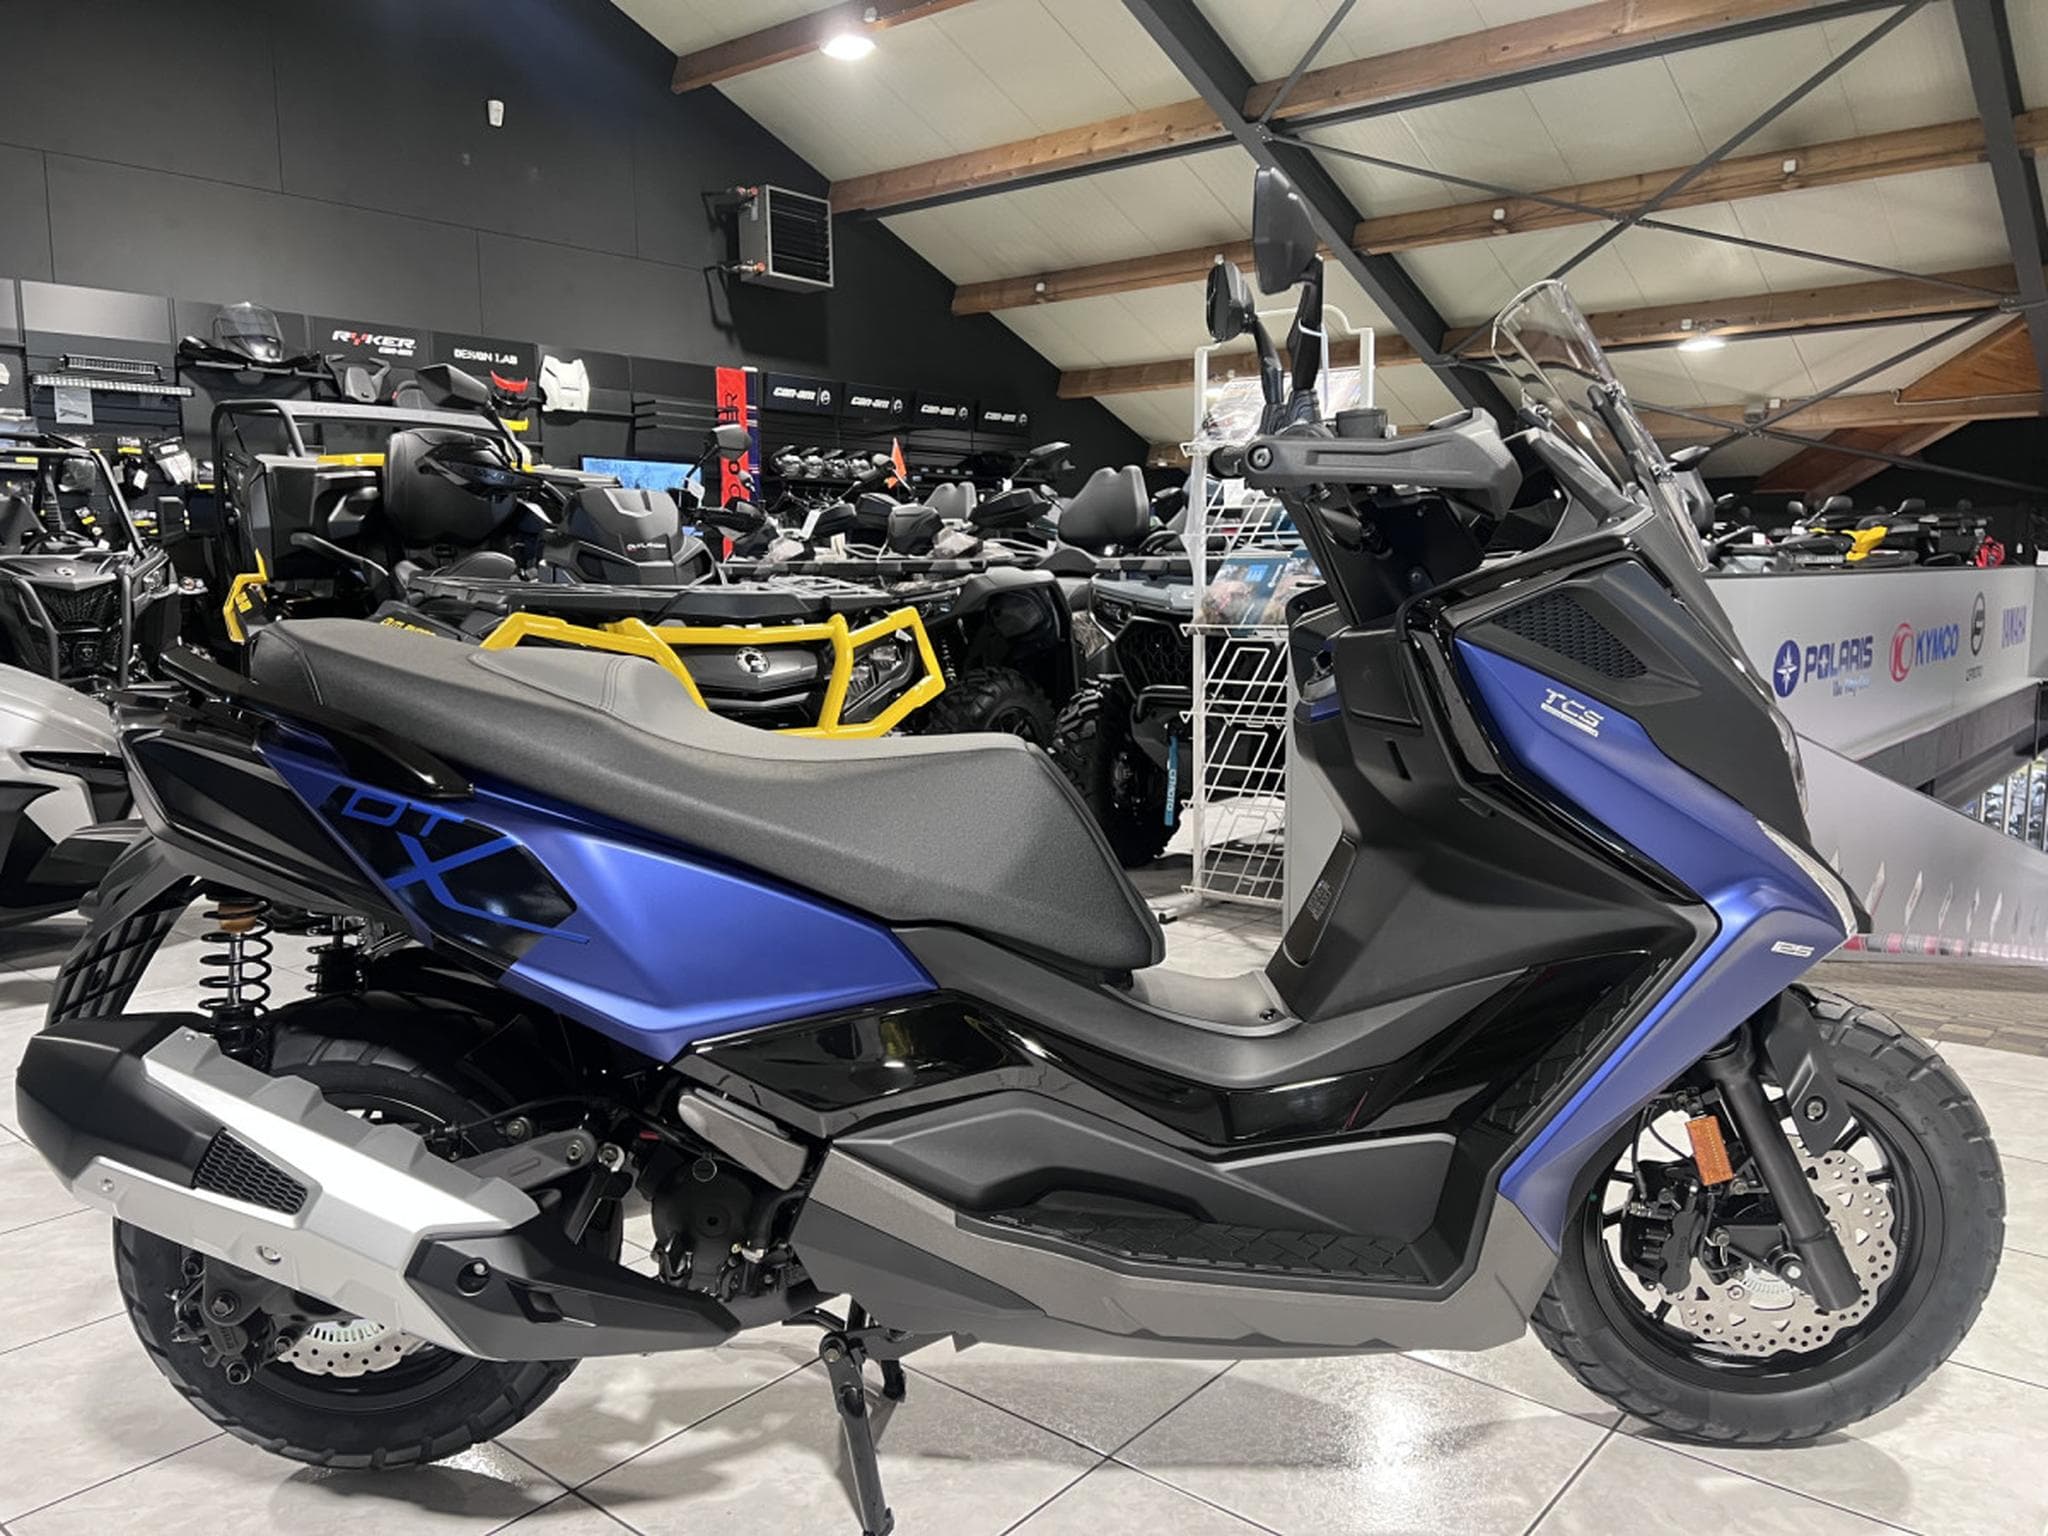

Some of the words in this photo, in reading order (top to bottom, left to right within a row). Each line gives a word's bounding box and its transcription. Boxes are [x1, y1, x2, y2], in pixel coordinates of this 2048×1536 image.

[332, 330, 416, 349] RYKER
[453, 348, 493, 362] DESIGN
[495, 353, 518, 365] LAB
[1804, 635, 1873, 683] POLARIS
[1915, 623, 1959, 666] KYMCO
[1545, 688, 1604, 728] TCS
[1771, 941, 1815, 957] 125
